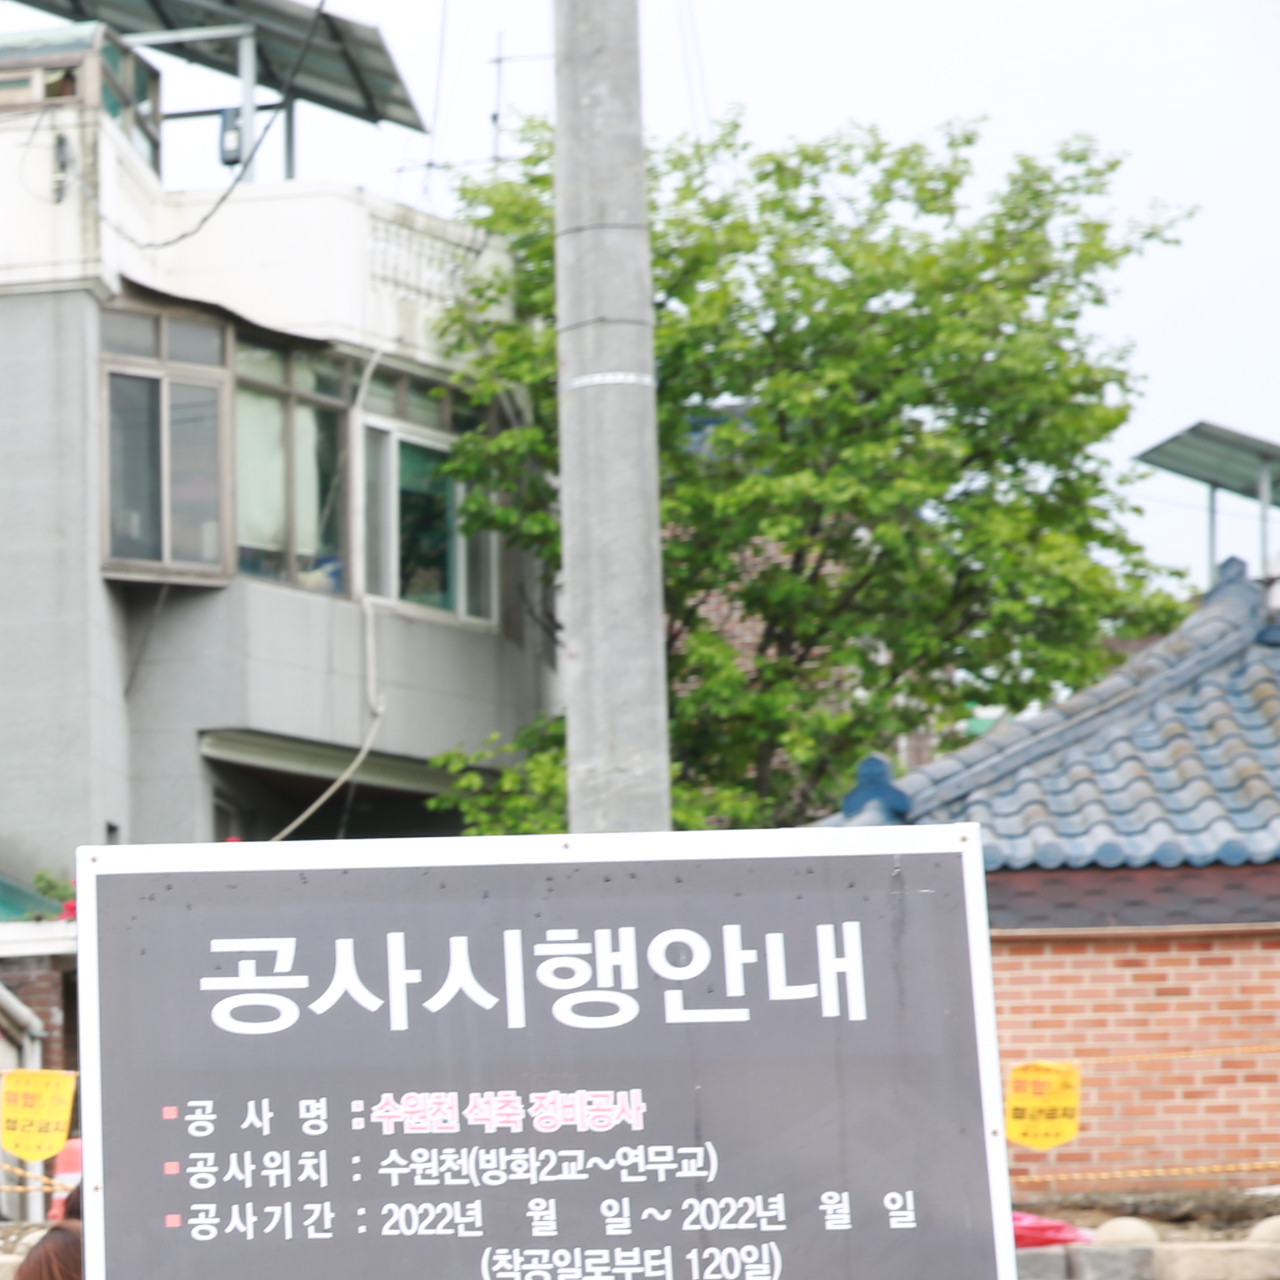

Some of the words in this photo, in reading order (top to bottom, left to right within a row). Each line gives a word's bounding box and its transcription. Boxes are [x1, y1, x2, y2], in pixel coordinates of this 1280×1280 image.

[199, 921, 867, 1034] 공사시행안내
[370, 1091, 460, 1134] 수원천
[463, 1090, 525, 1132] 석축
[529, 1089, 647, 1132] 정비공사
[186, 1149, 329, 1190] 공사위치
[378, 1141, 719, 1187] 수원천(방화2교~연무교)
[187, 1202, 335, 1240] 공사기간
[380, 1199, 484, 1237] 2022년
[525, 1198, 558, 1236] 월
[600, 1197, 632, 1235] 일
[681, 1193, 787, 1231] 2022년
[818, 1191, 852, 1230] 월
[883, 1190, 917, 1229] 일
